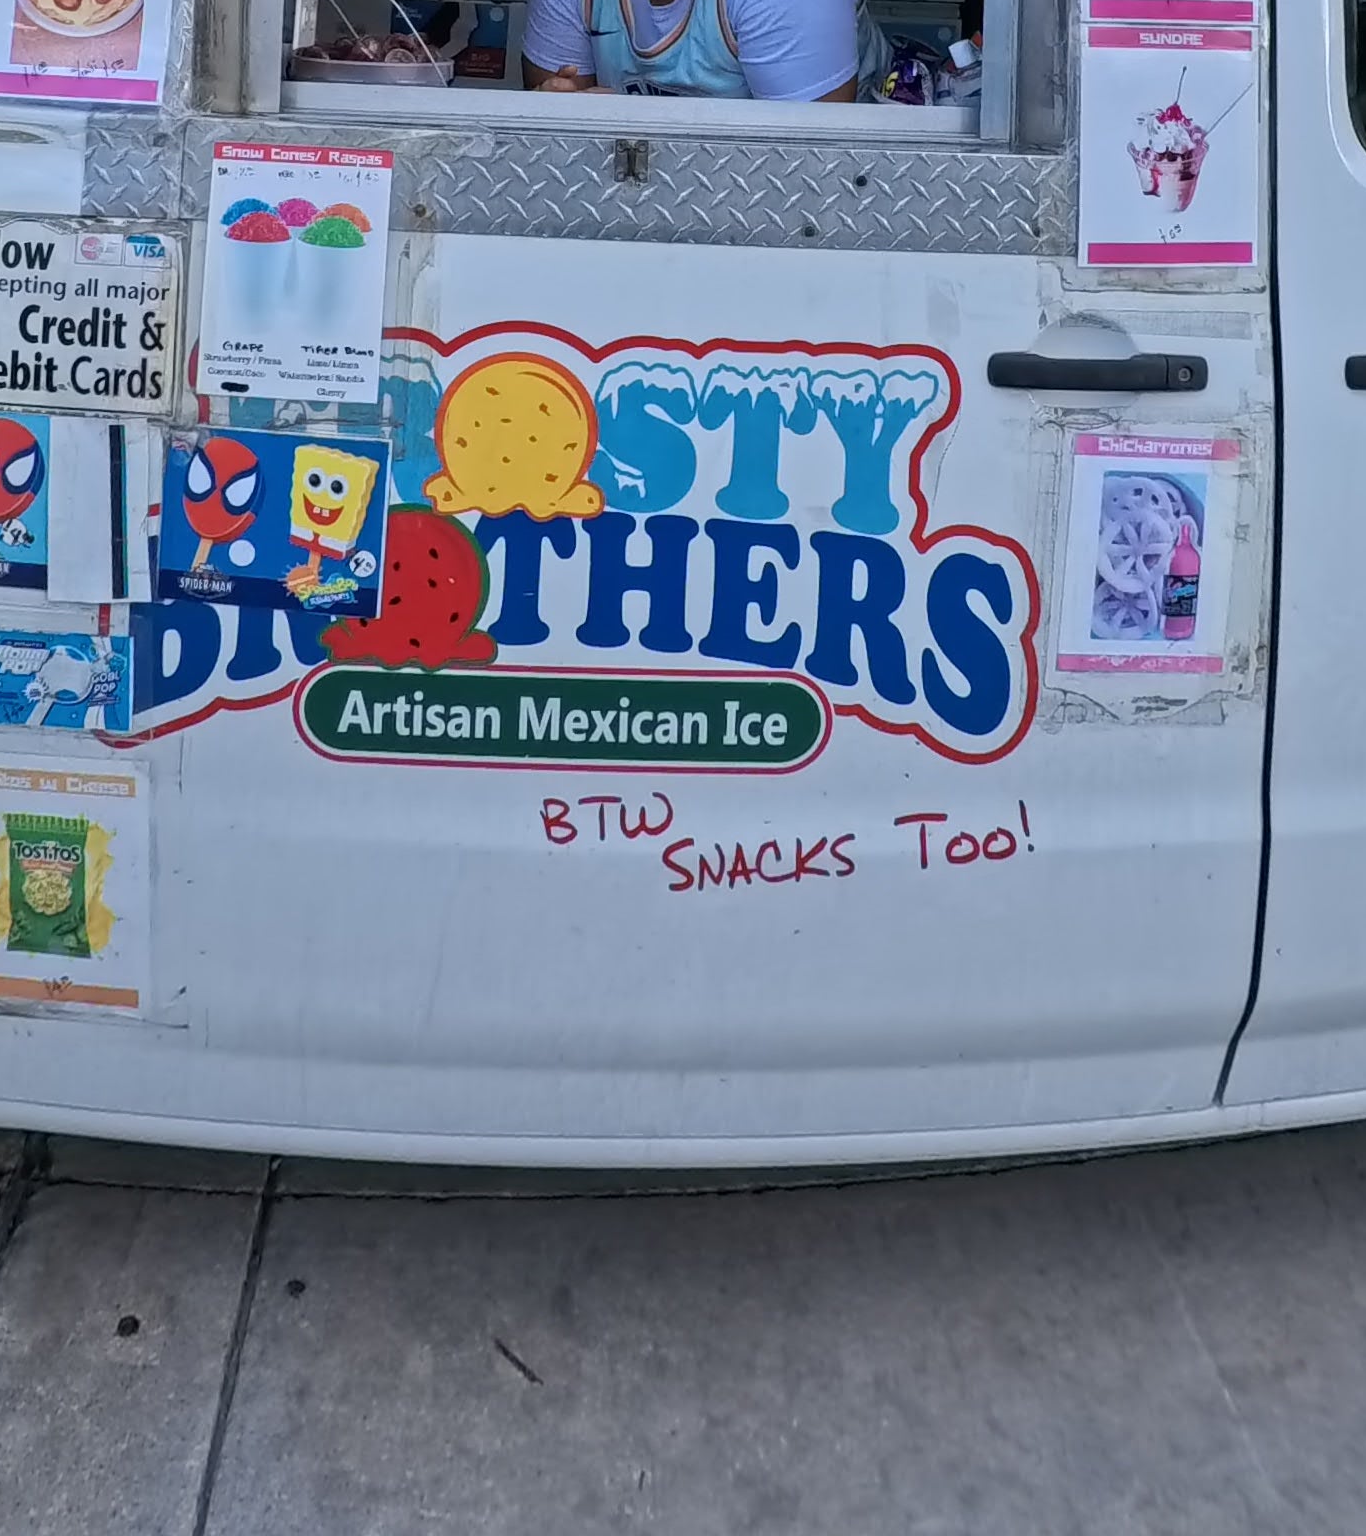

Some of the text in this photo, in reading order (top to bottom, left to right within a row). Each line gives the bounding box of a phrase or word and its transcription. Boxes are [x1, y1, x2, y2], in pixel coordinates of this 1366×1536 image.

[1139, 32, 1203, 46] SUNDAE
[221, 145, 383, 168] Snow Cones/ Raspas
[134, 245, 166, 258] VISA
[75, 277, 100, 298] all
[106, 280, 171, 306] major
[18, 303, 166, 352] Credit &
[69, 355, 164, 400] Cards
[1098, 436, 1213, 456] Chicharrones
[179, 576, 232, 593] SPIDER-MAN
[94, 682, 116, 694] POP
[337, 689, 789, 748] Artisan Mexican Ice
[540, 792, 674, 845] BTW
[14, 841, 82, 863] TOSTITOS
[663, 831, 856, 894] SNACKS
